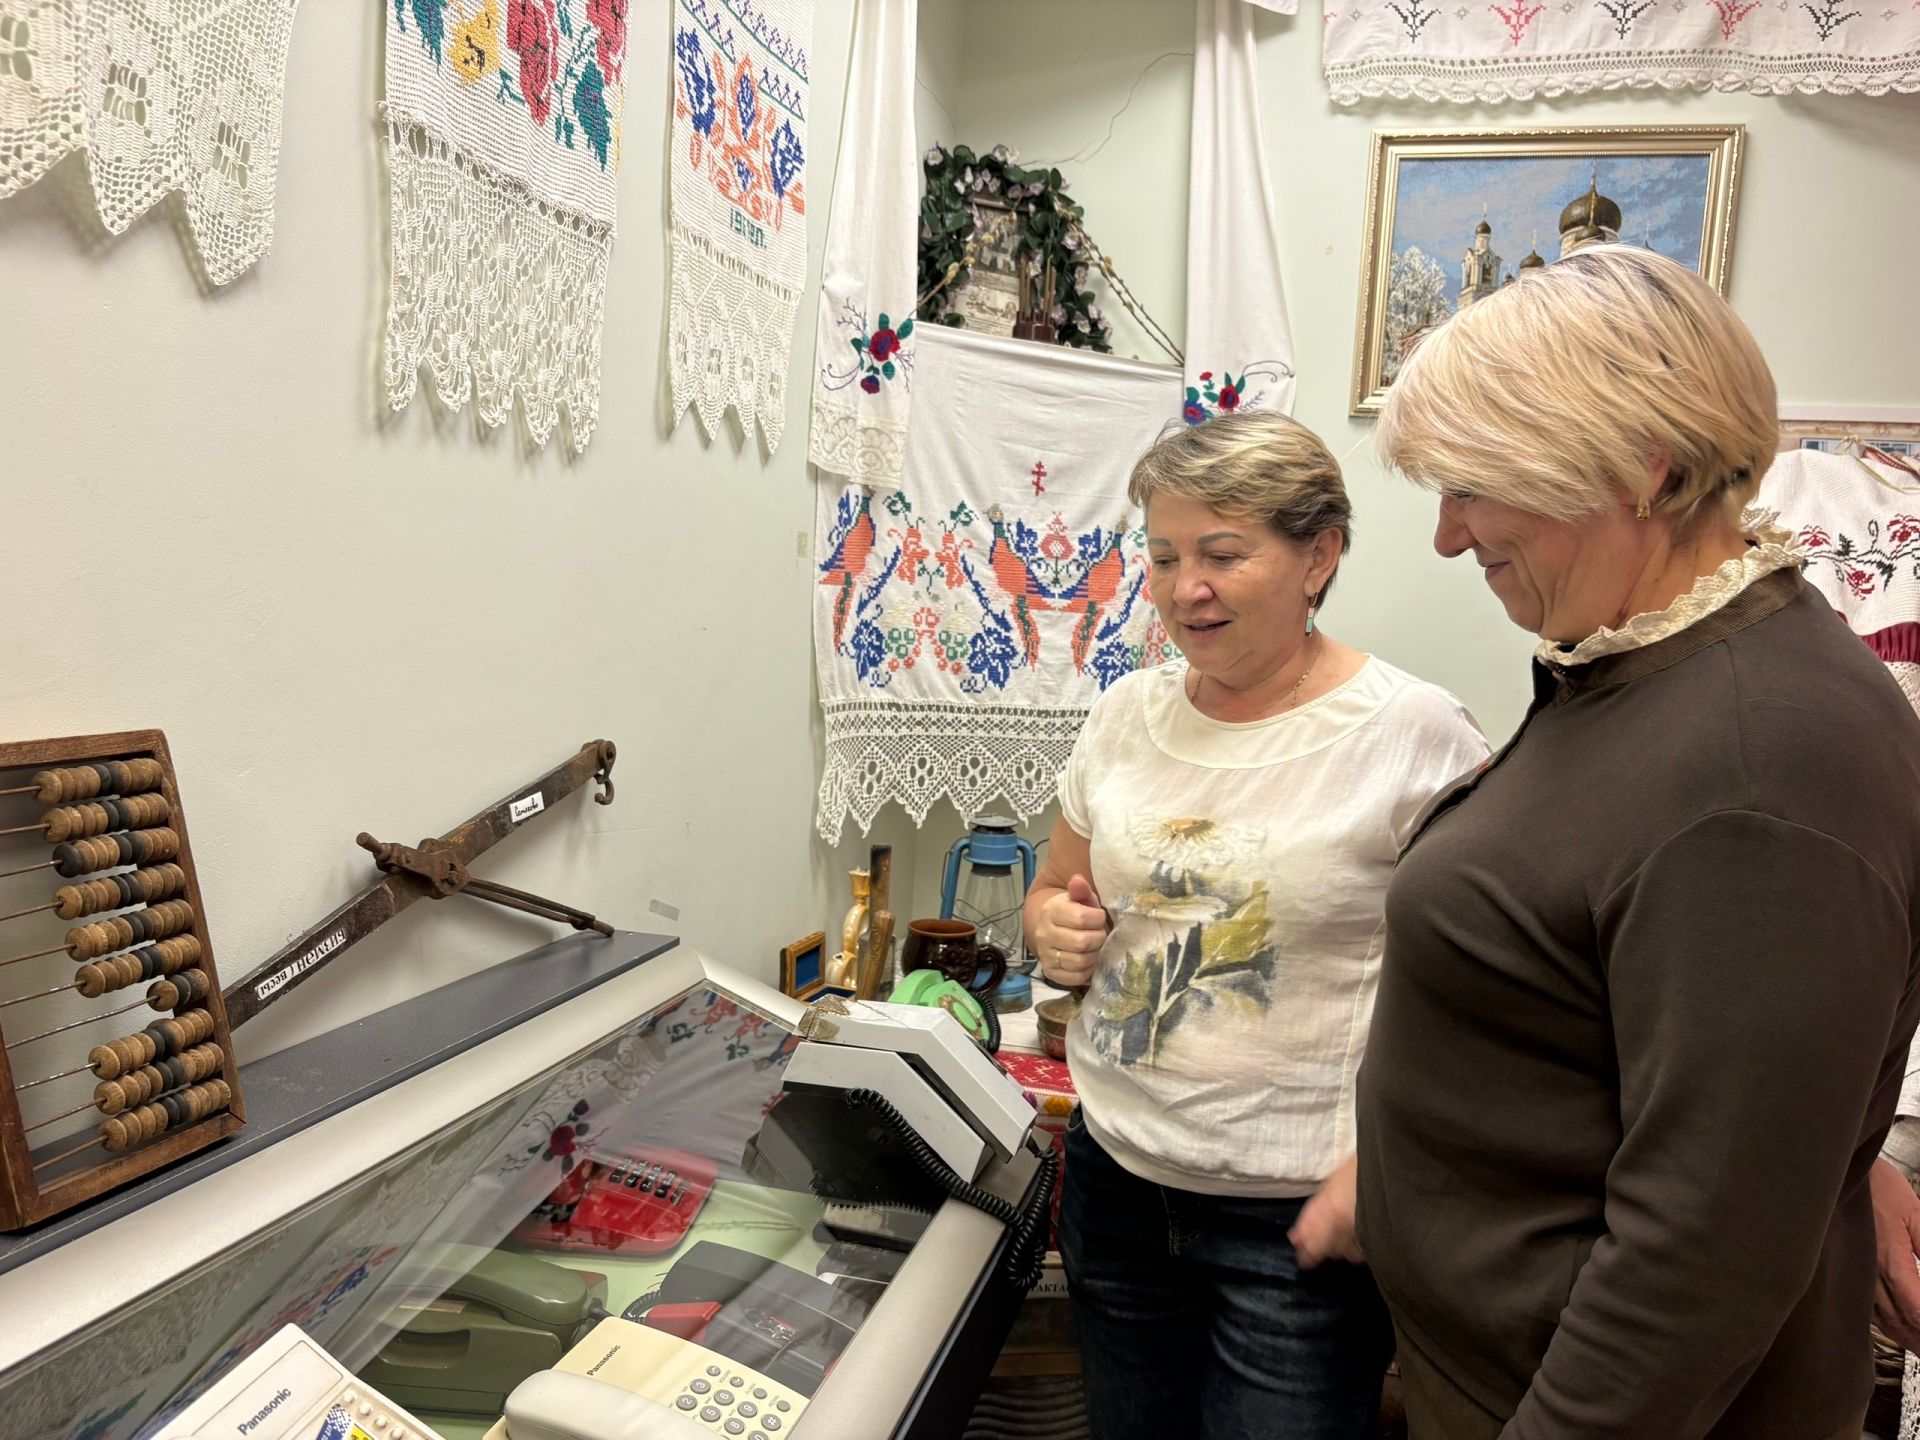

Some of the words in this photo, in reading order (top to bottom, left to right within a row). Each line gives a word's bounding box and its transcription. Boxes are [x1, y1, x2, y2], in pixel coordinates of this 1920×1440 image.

[586, 1344, 621, 1376] Panasonic
[682, 1397, 693, 1405] 2
[695, 1381, 706, 1389] 3
[705, 1409, 716, 1417] 5
[719, 1392, 730, 1400] 6
[236, 1386, 292, 1436] Panasonic
[730, 1421, 740, 1429] 8
